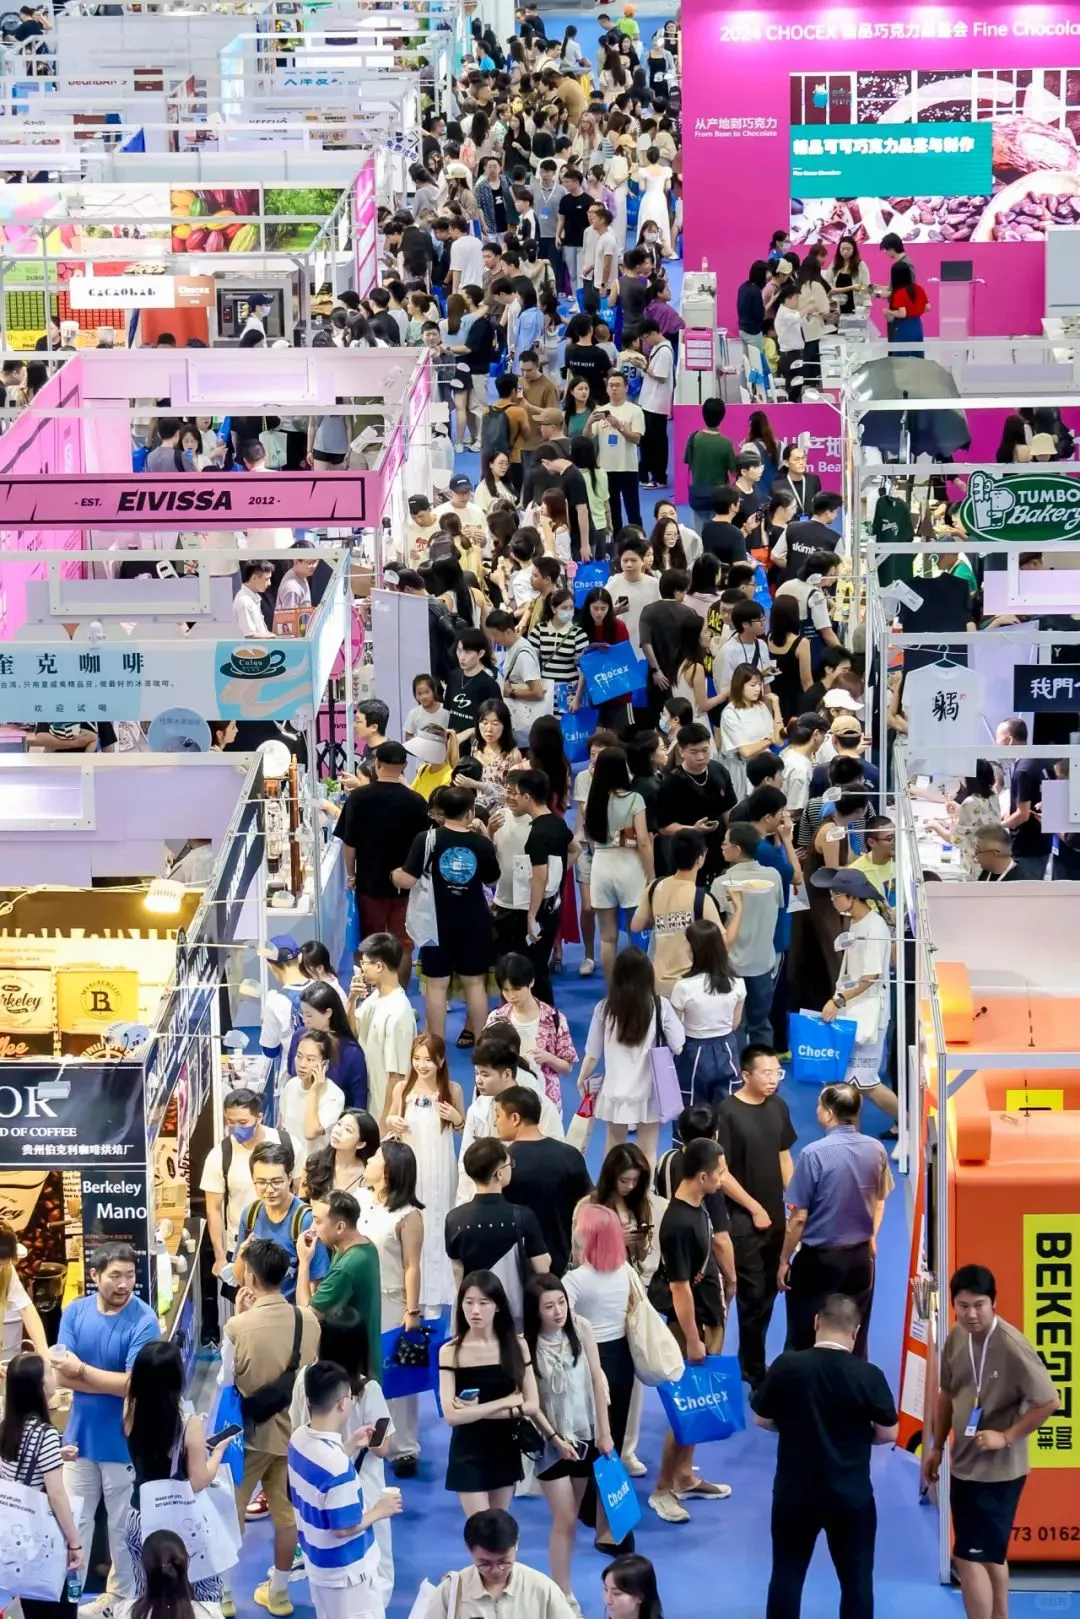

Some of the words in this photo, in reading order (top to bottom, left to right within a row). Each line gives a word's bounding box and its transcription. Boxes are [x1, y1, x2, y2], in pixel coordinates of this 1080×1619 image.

[720, 26, 761, 41] 2024
[766, 25, 836, 41] CHOCEX
[973, 22, 1008, 37] Fine
[1012, 20, 1080, 37] Chocola
[695, 117, 777, 130] 从产地到巧克力
[622, 365, 638, 380] 23
[117, 488, 232, 516] EIVISSA
[248, 496, 275, 505] 2012
[1017, 488, 1080, 504] TUMBO
[1007, 503, 1080, 530] Bakery
[1030, 676, 1080, 700] 我門
[89, 990, 114, 1013] B
[10, 1127, 29, 1137] OF
[30, 1127, 78, 1137] COFFEE
[21, 1144, 135, 1156] 贵州伯克利咖啡烘焙厂
[82, 1180, 142, 1197] Berkeley
[96, 1202, 147, 1219] Mano
[673, 1390, 729, 1412] Chocex
[1038, 1526, 1080, 1541] 0162
